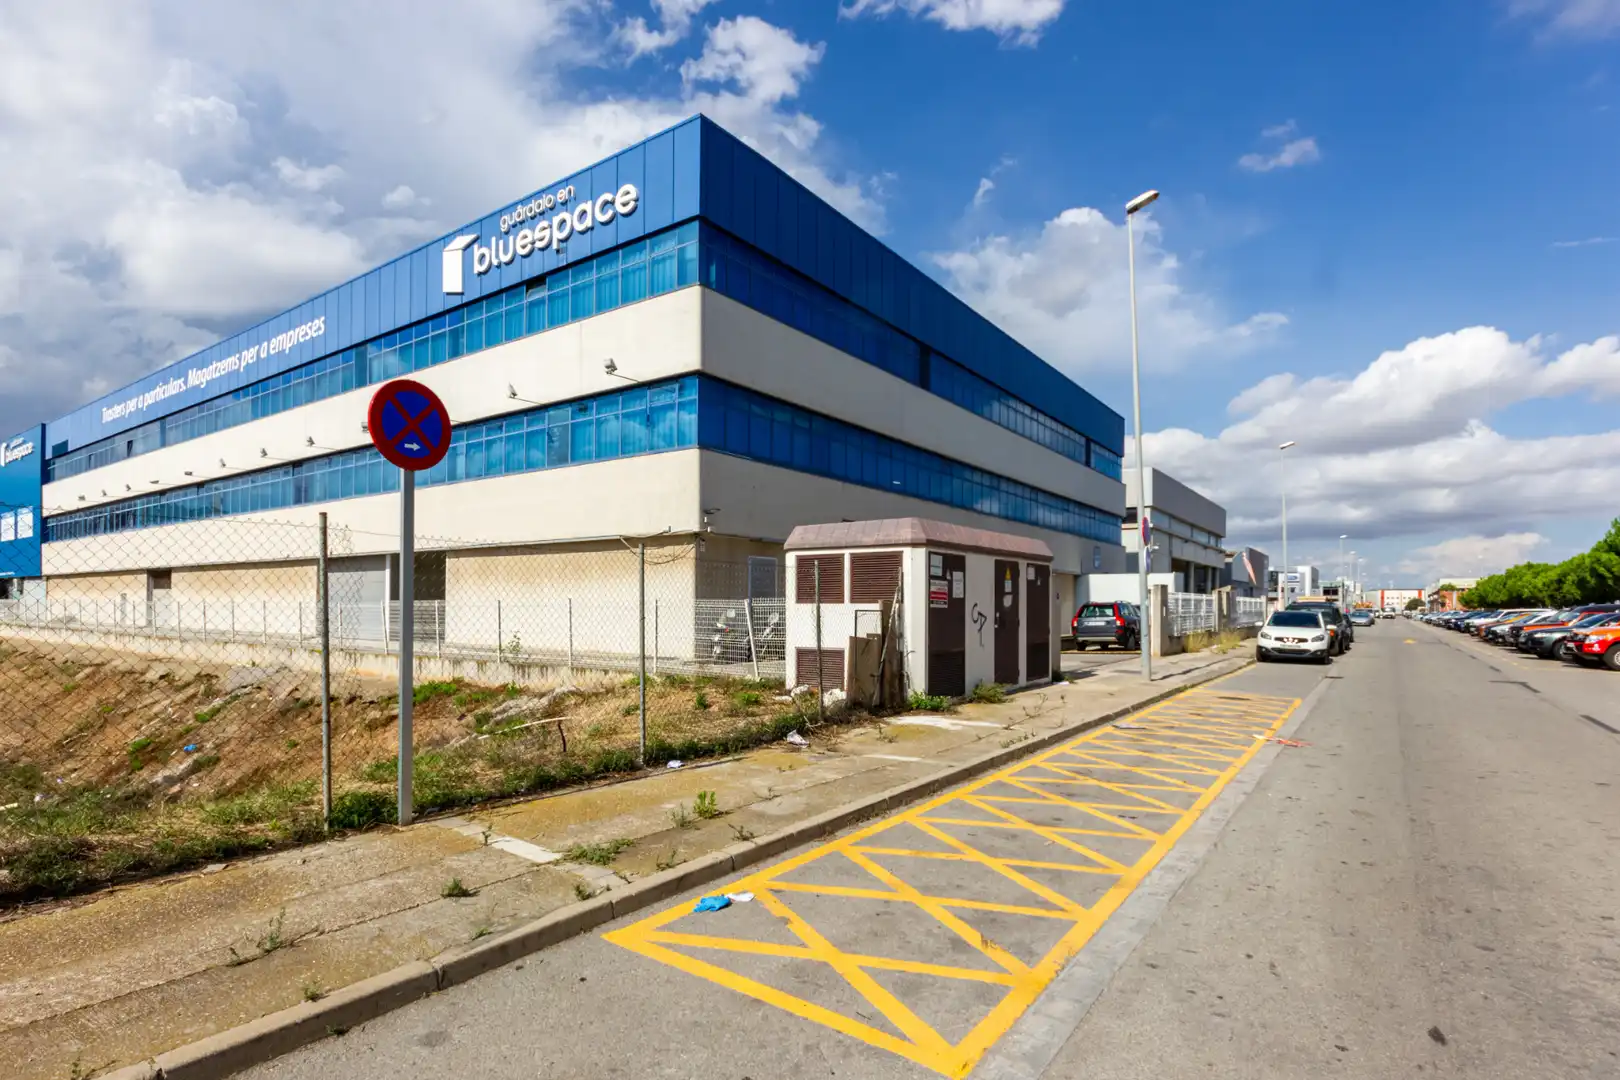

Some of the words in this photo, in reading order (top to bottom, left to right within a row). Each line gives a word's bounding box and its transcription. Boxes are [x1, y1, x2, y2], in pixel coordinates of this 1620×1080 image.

[473, 183, 639, 275] bluespace
[557, 185, 575, 203] en
[125, 396, 138, 418] per
[138, 394, 143, 408] a
[187, 354, 240, 388] Magatzems
[240, 344, 259, 372] per
[260, 341, 268, 358] a
[269, 316, 325, 355] empreses
